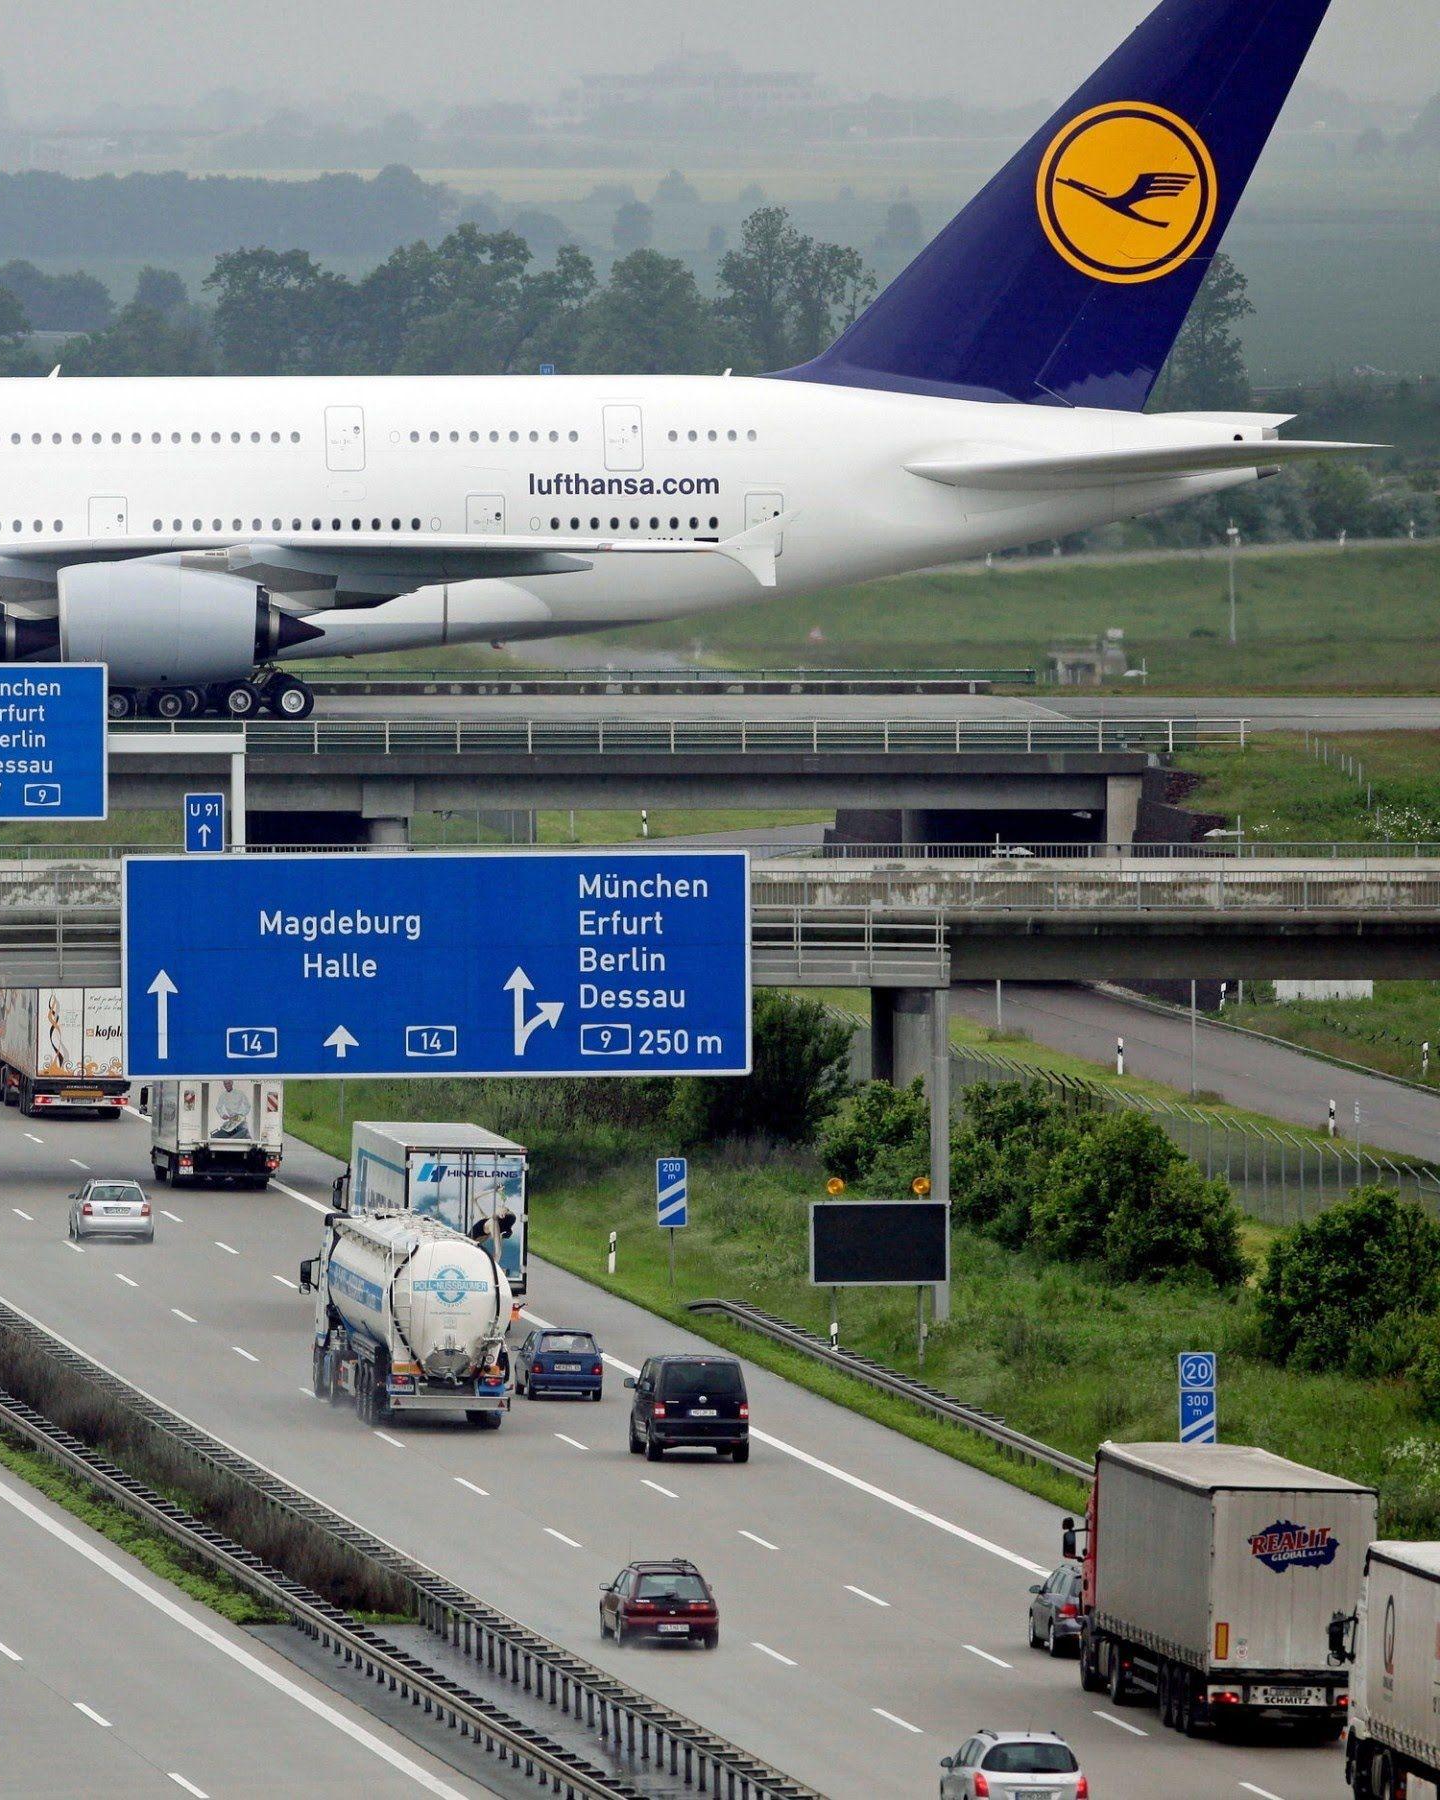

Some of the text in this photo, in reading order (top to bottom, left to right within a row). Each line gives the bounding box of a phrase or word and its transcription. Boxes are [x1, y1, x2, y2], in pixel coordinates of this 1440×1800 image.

[529, 473, 720, 495] lufthansa.com
[37, 789, 47, 803] 9
[190, 803, 219, 816] U 91
[579, 873, 708, 899] München
[260, 909, 421, 941] Magdeburg
[579, 910, 663, 936] Erfurt
[304, 952, 377, 978] Halle
[579, 946, 665, 972] Berlin
[580, 983, 685, 1009] Dessau
[241, 1033, 262, 1052] 14
[419, 1032, 442, 1051] 14
[600, 1029, 722, 1055] 9 250 m
[447, 1170, 518, 1179] HINDELANG
[663, 1162, 681, 1172] 200
[1186, 1365, 1209, 1380] 20
[1186, 1395, 1209, 1407] 300
[1193, 1408, 1202, 1416] m
[1251, 1527, 1331, 1556] REALIT
[1271, 1550, 1307, 1562] GLOBAL
[1264, 1697, 1310, 1705] SCHMITZ
